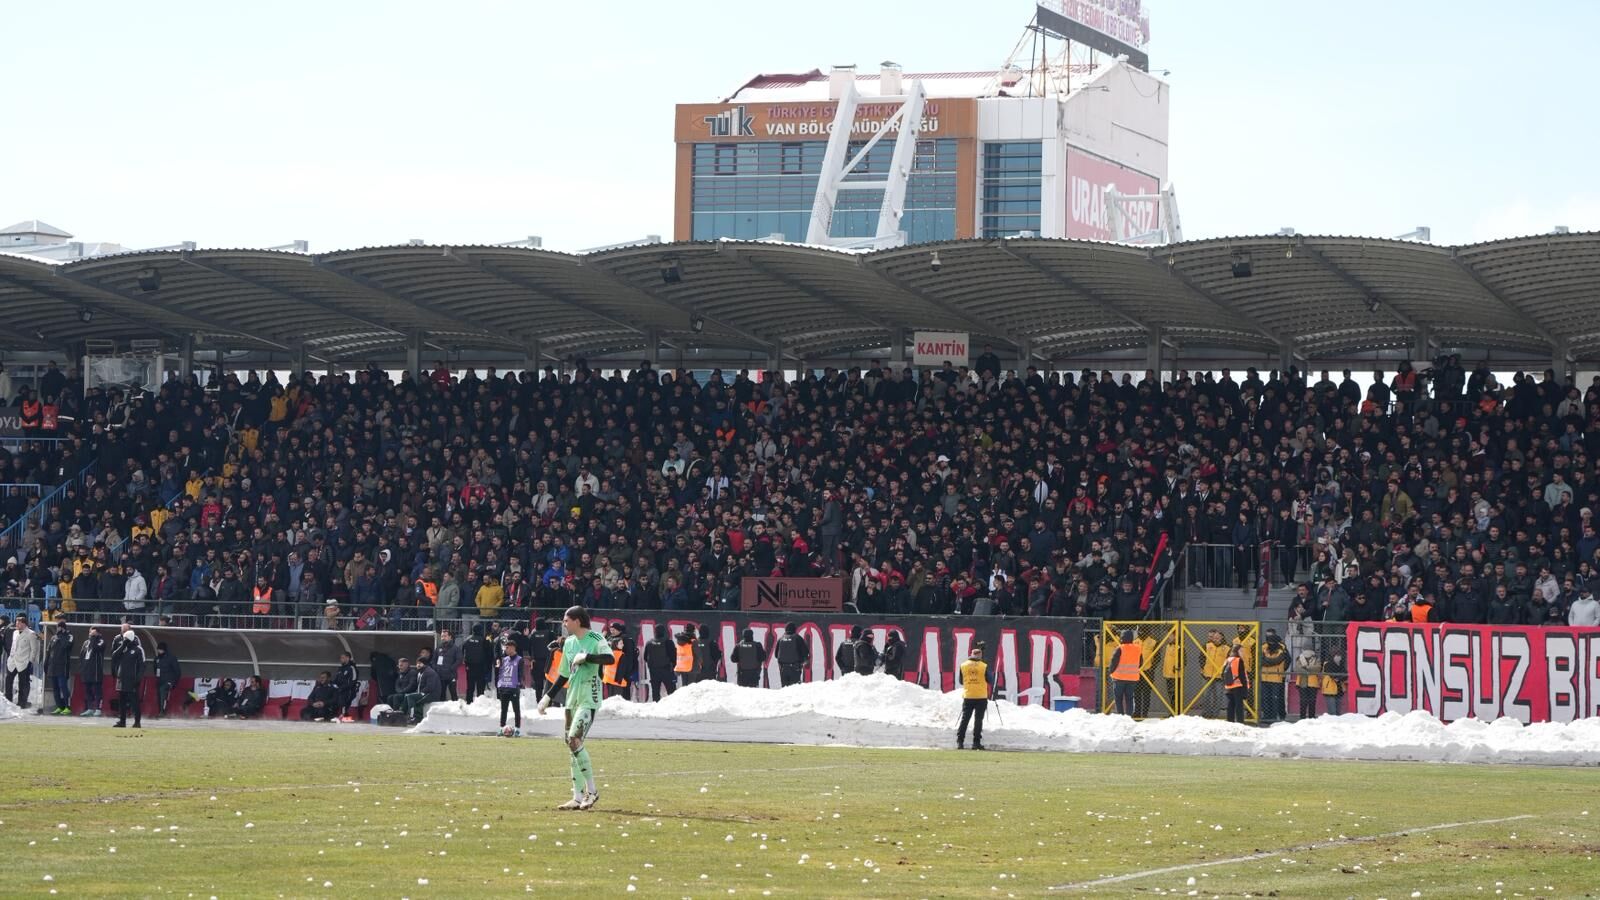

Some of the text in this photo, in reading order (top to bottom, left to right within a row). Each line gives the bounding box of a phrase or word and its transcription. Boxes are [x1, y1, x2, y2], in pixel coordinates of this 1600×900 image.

[766, 122, 795, 136] VAN
[799, 120, 834, 135] BÖLG
[917, 340, 965, 356] KANTİN
[1356, 626, 1531, 726] SONSUZ
